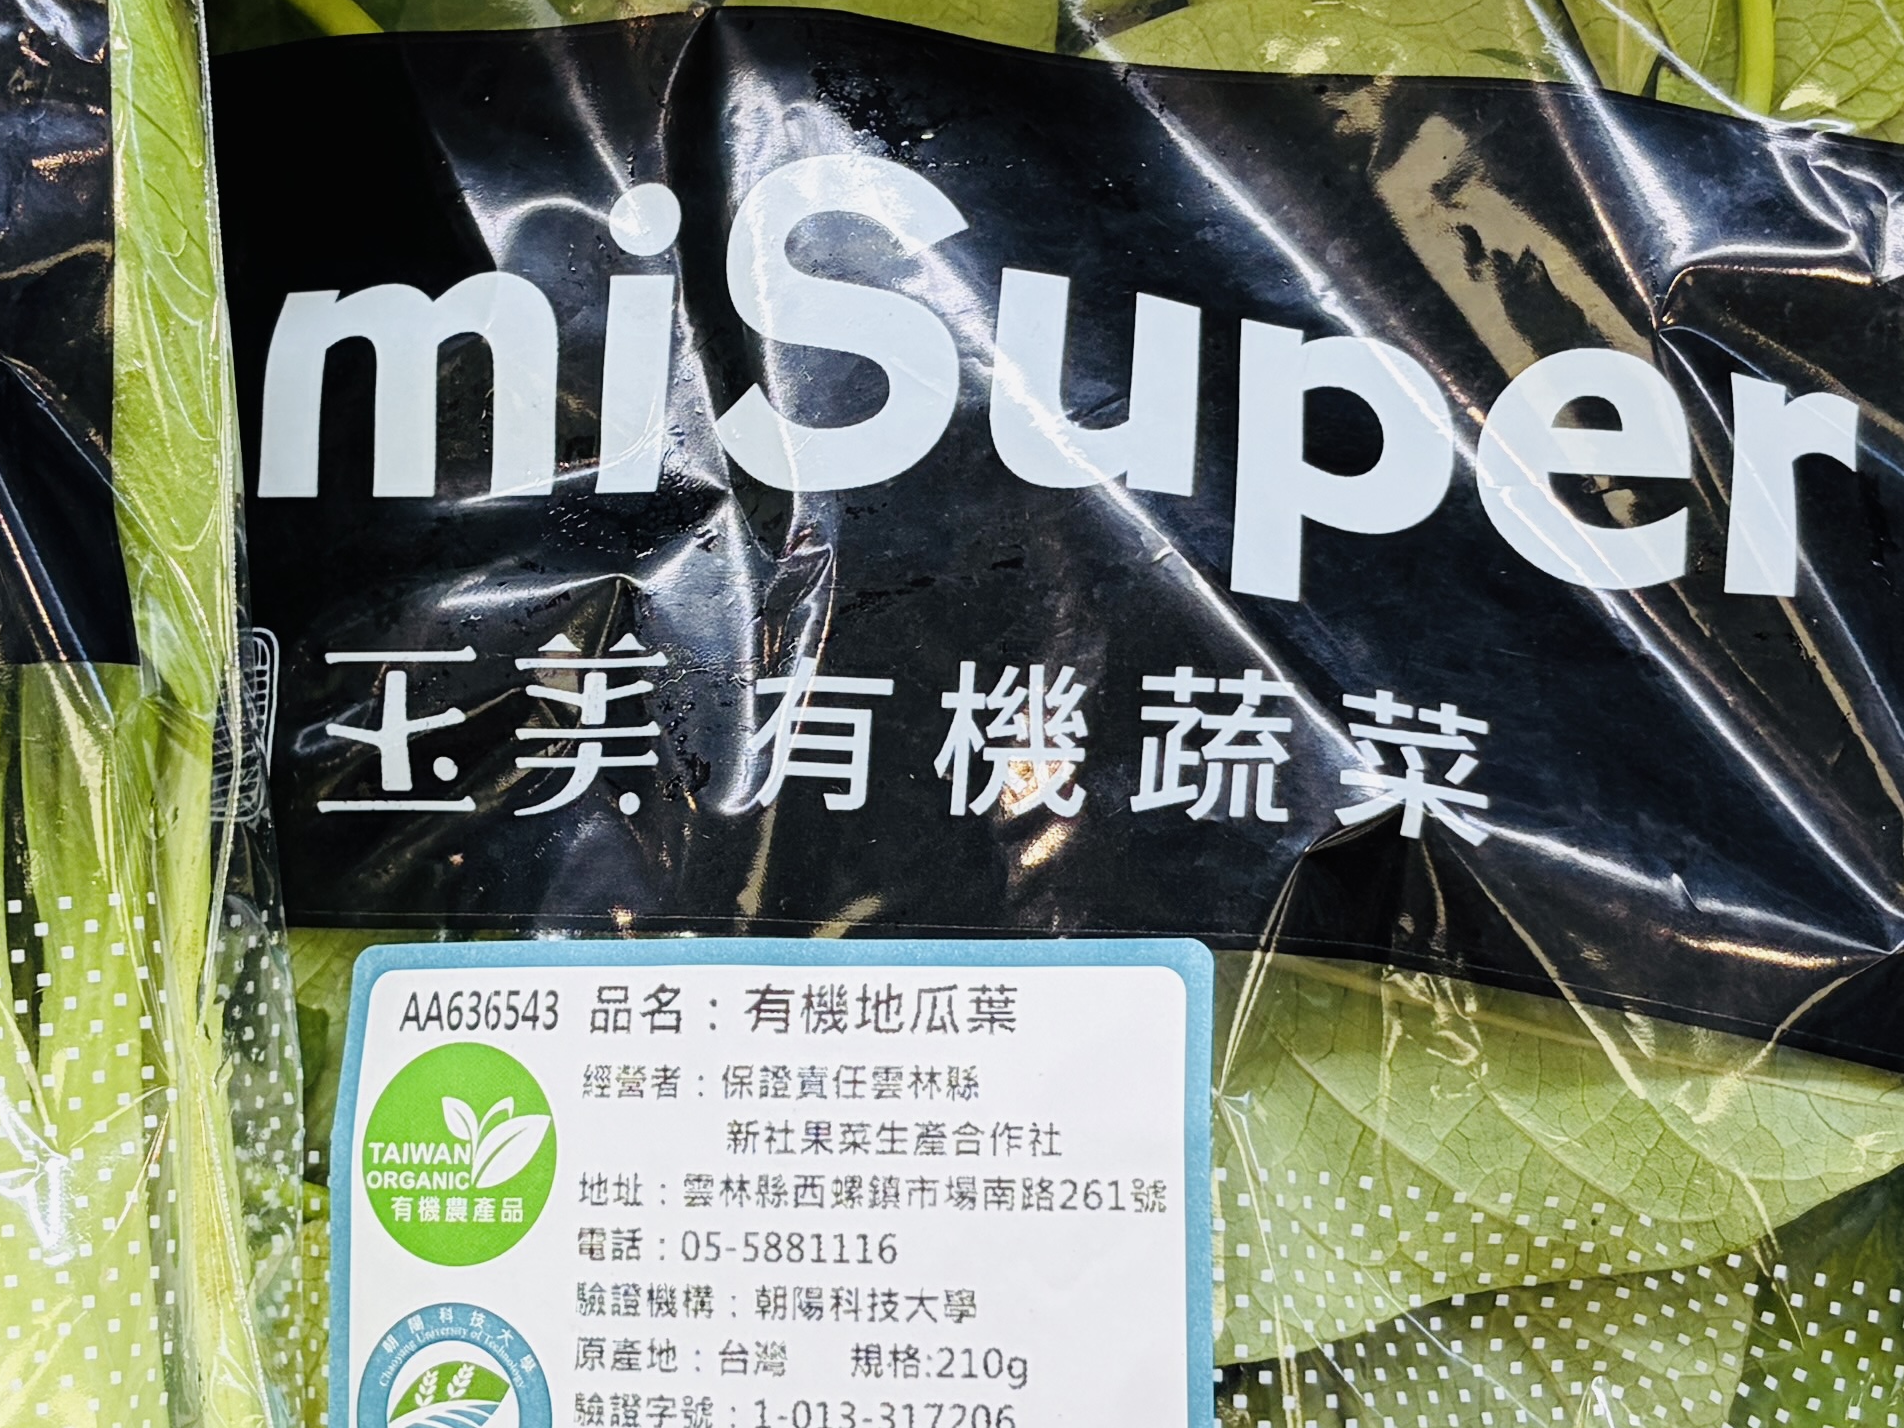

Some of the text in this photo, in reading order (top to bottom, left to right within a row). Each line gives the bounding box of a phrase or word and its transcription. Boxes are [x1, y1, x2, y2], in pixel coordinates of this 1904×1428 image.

[399, 988, 560, 1033] AA636543
[368, 1141, 472, 1166] TAIWAN
[365, 1170, 471, 1190] ORGANIC
[390, 1194, 525, 1223] 有機農產品
